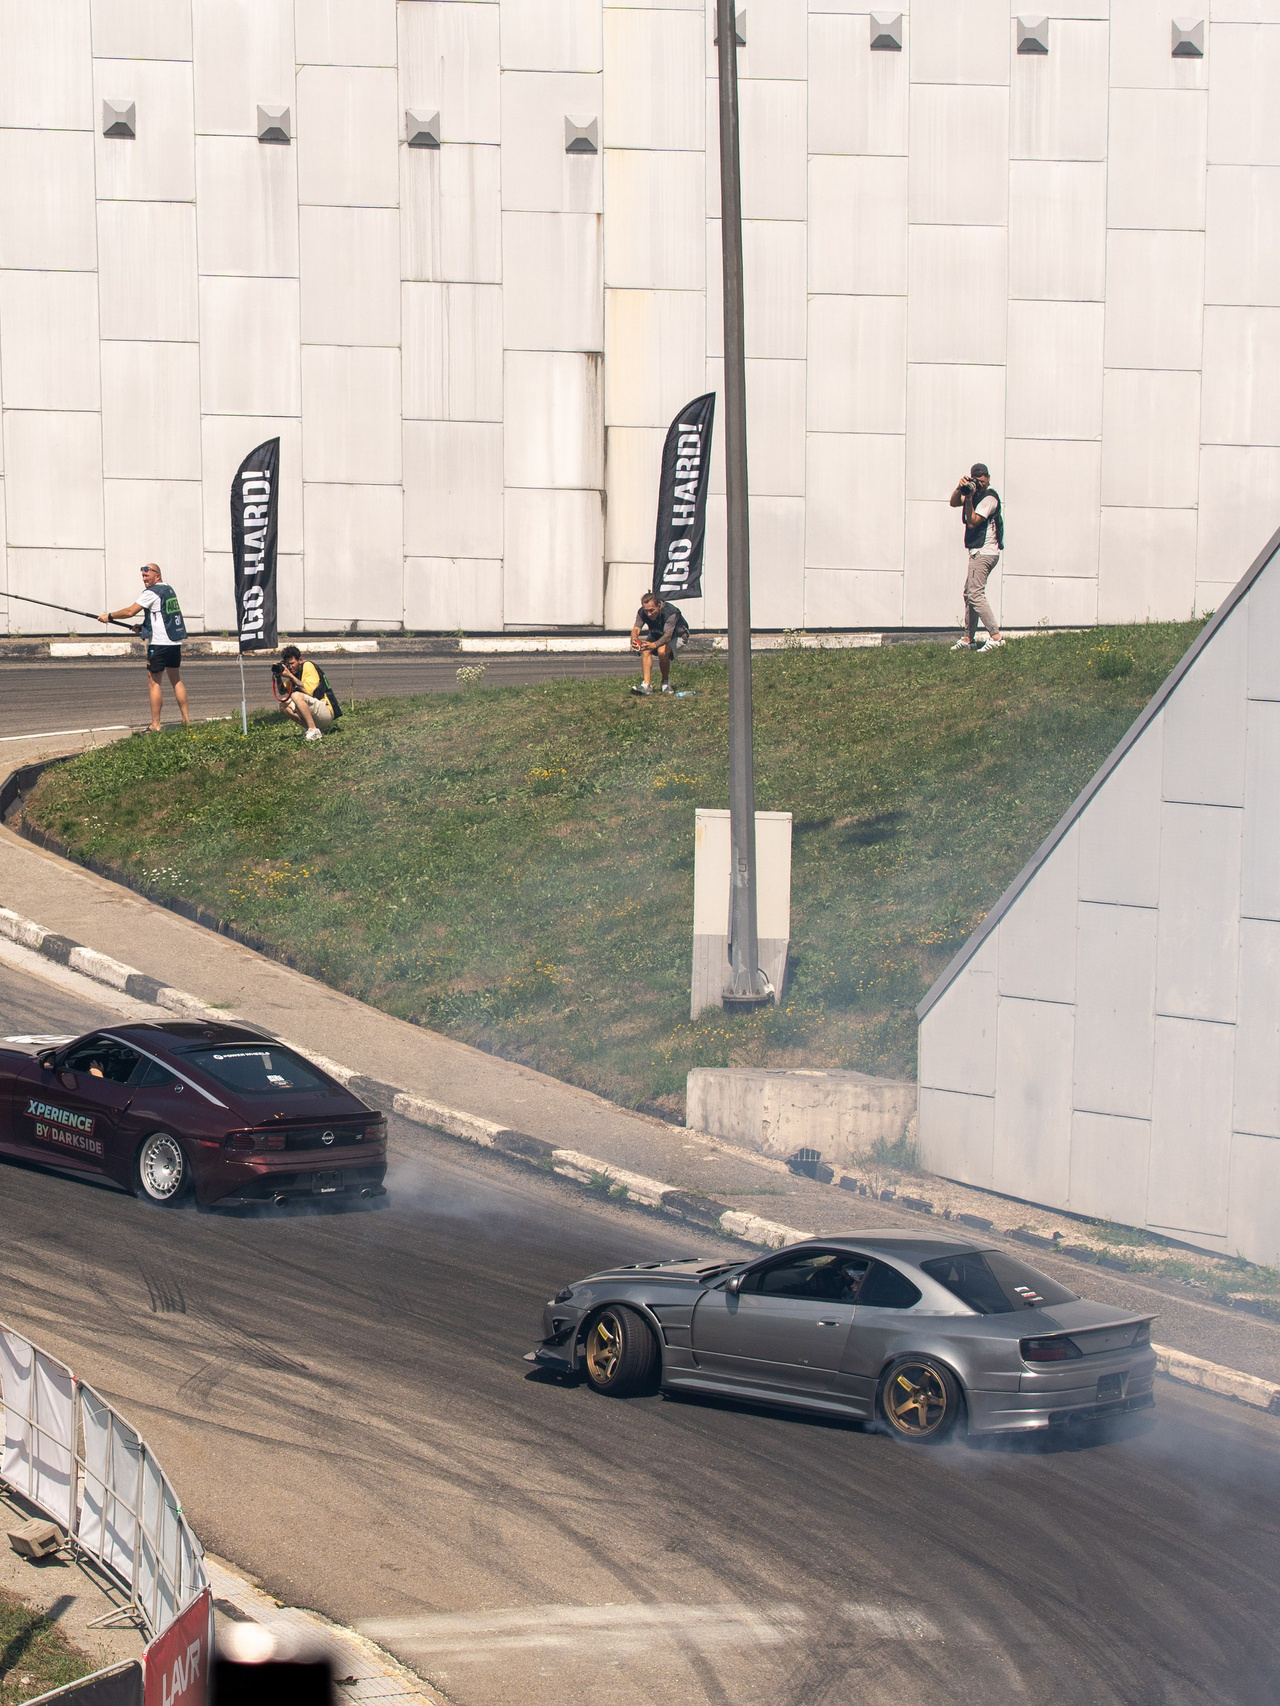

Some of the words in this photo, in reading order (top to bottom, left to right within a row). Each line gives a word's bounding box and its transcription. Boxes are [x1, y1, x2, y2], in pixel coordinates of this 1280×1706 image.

[672, 422, 703, 527] HARD!
[27, 1099, 93, 1132] XPERIENCE
[36, 1123, 50, 1137] BY
[51, 1127, 102, 1154] DARKSIDE
